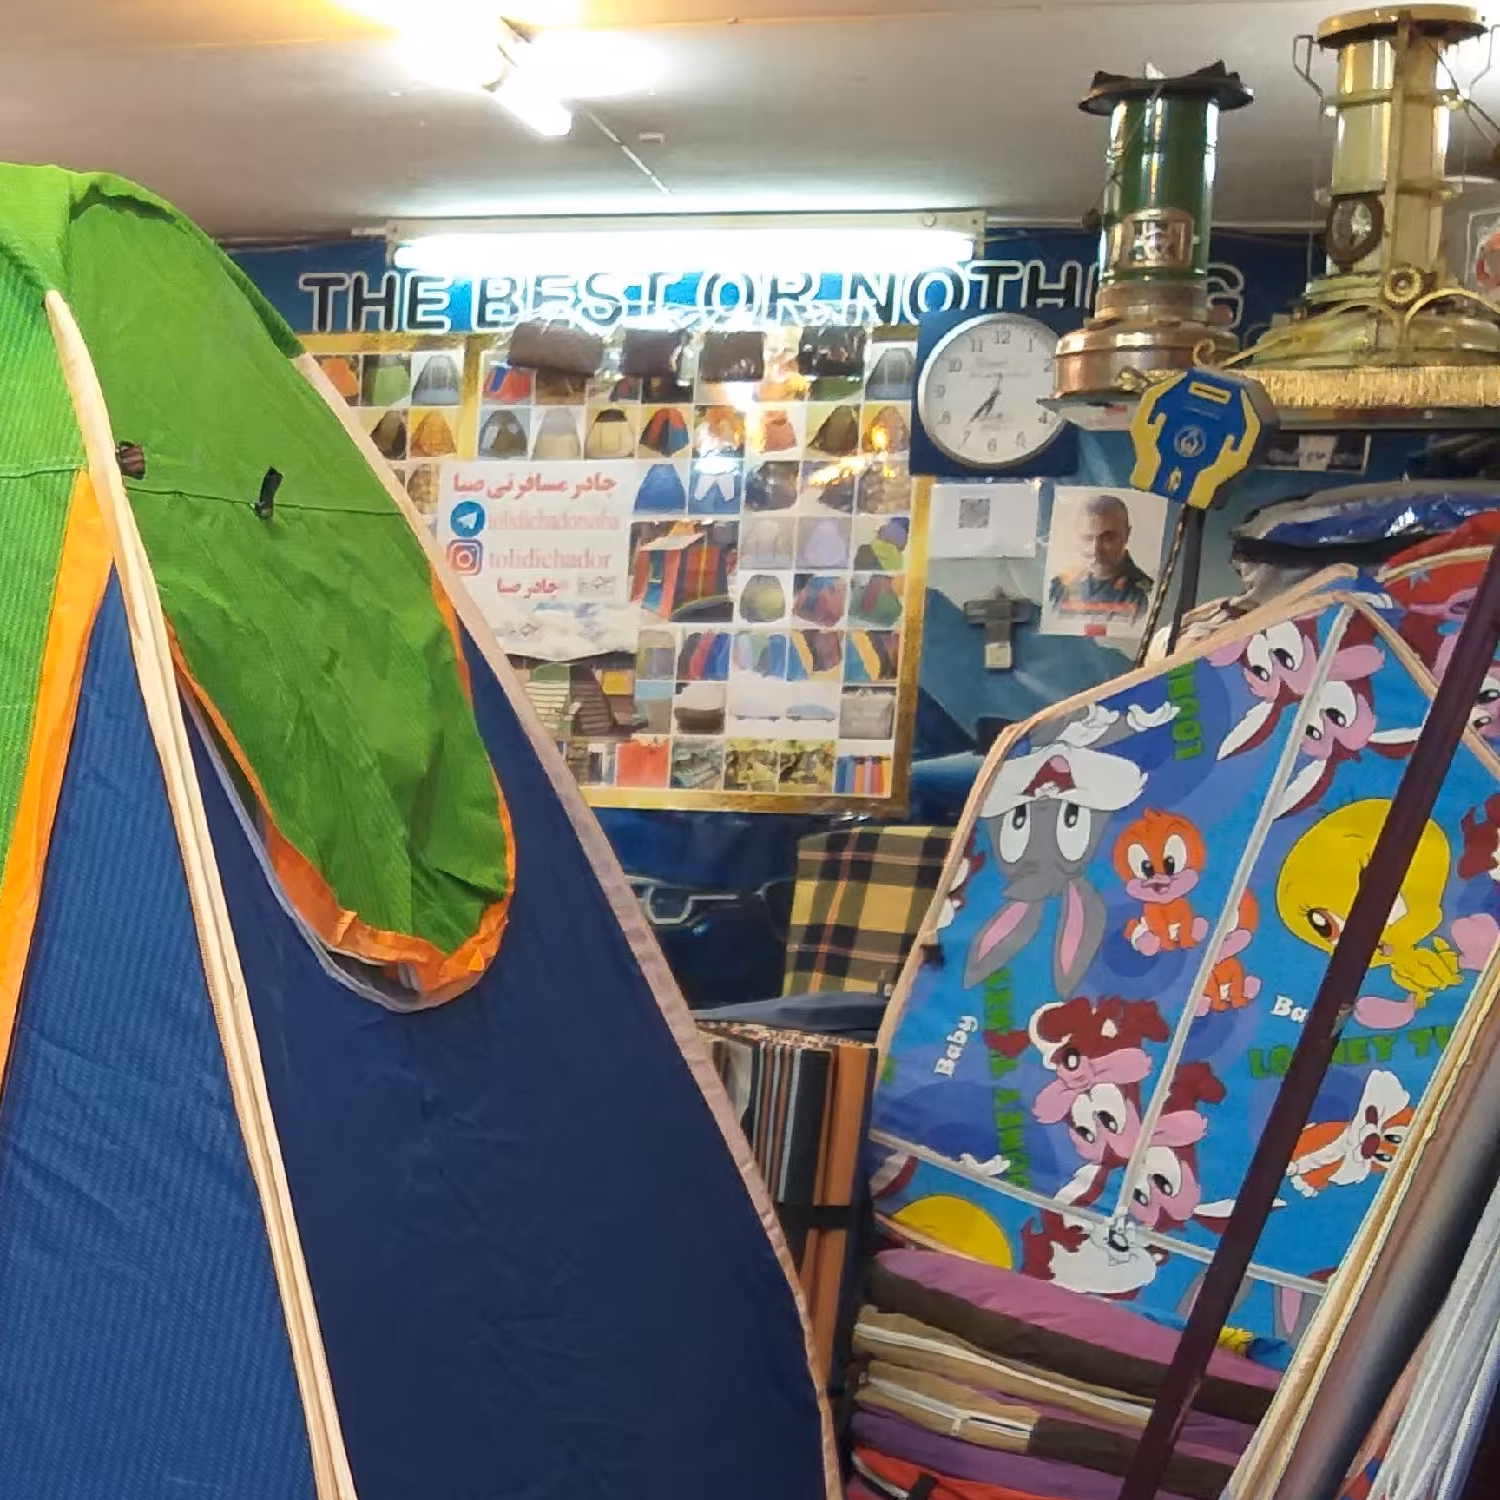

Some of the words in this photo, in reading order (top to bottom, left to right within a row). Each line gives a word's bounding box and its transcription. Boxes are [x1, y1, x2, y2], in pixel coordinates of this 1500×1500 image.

[298, 272, 451, 334] THE
[700, 270, 822, 326] OR
[994, 328, 1011, 345] 12
[1270, 995, 1309, 1024] Ba
[933, 1014, 979, 1079] Baby
